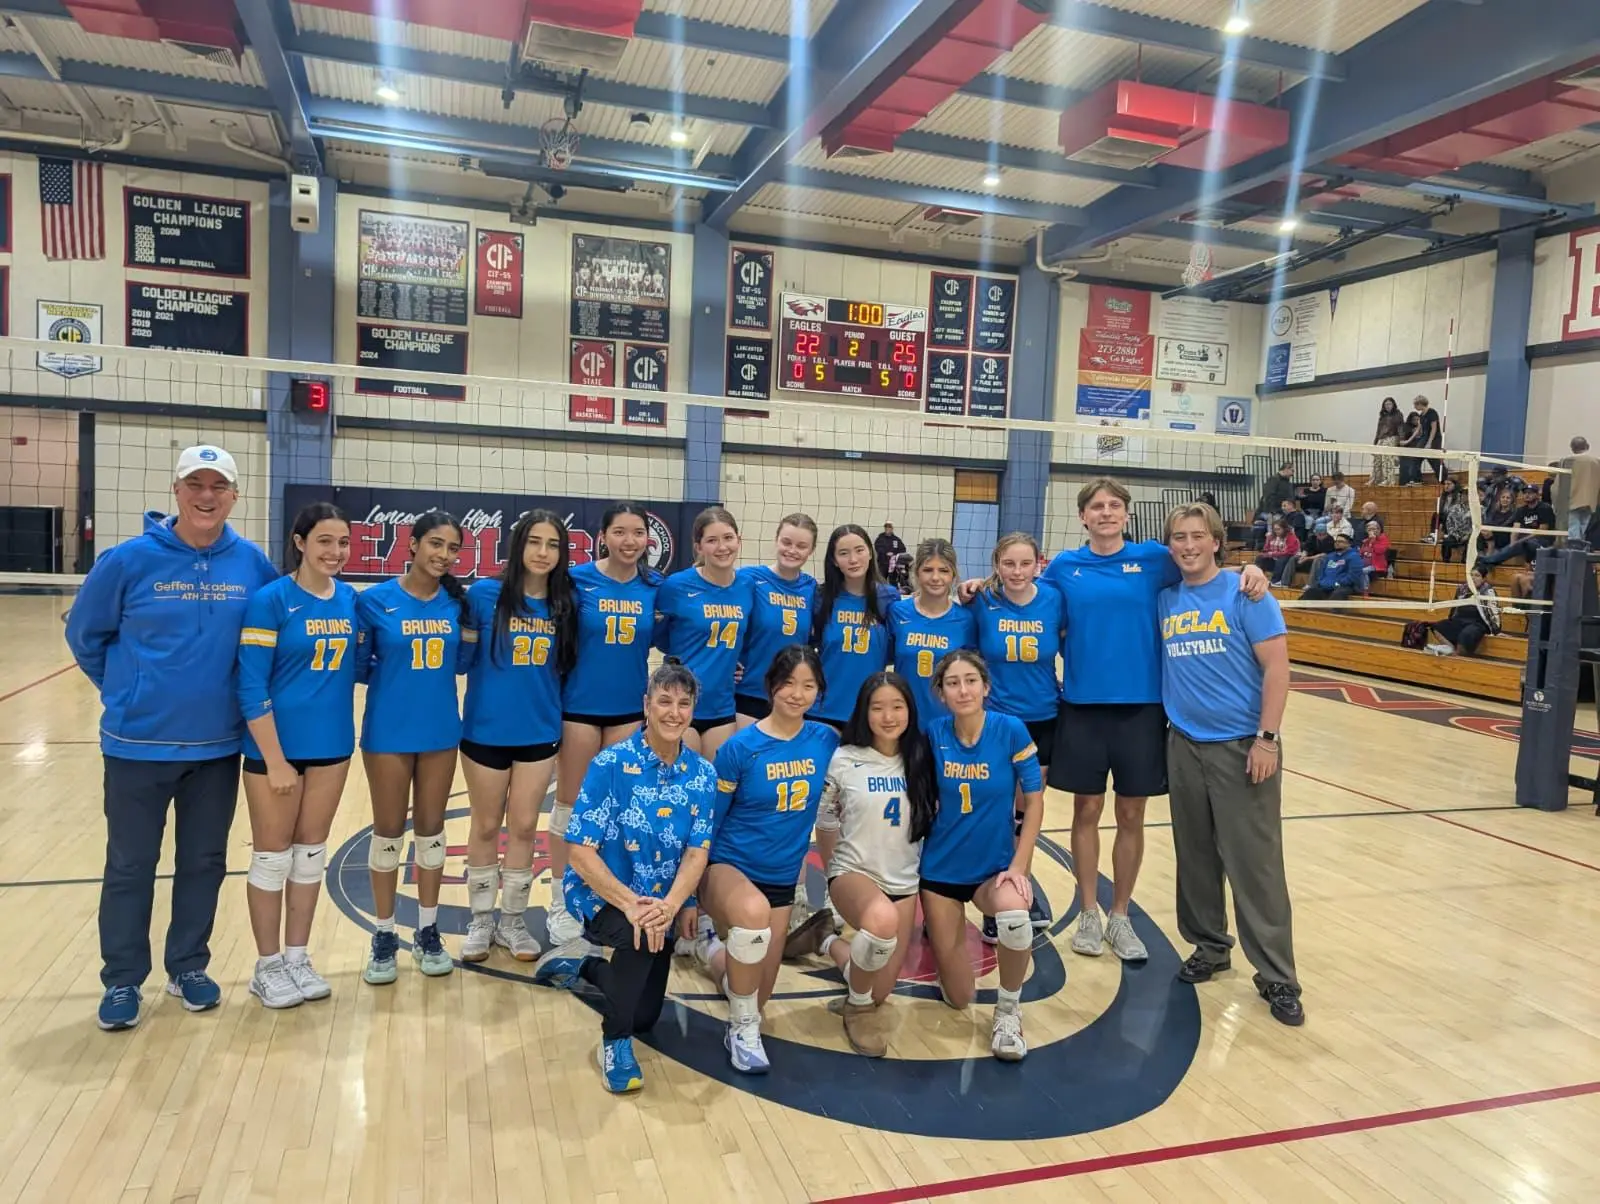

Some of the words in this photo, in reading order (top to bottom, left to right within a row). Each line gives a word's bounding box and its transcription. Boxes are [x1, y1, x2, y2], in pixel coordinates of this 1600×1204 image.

[133, 195, 182, 211] GOLDEN
[194, 202, 242, 218] LEAGUE
[134, 224, 153, 233] 2001
[153, 212, 223, 230] CHAMPIONS
[486, 243, 513, 270] CIF
[741, 261, 764, 286] CIF
[142, 286, 186, 300] GOLDEN
[190, 291, 233, 306] LEAGUE
[944, 279, 960, 296] CIF
[988, 285, 1003, 302] CIF
[155, 312, 174, 321] 2021
[156, 300, 218, 316] CHAMPIONS
[848, 303, 883, 325] 1:00
[131, 318, 151, 328] 2019
[789, 320, 822, 333] EAGLES
[887, 310, 925, 328] Eagles
[131, 328, 152, 338] 2020
[371, 328, 412, 341] GOLDEN
[416, 331, 454, 345] LEAGUE
[844, 331, 865, 339] PERIOD
[889, 331, 918, 342] GUEST
[384, 340, 441, 354] CHAMPIONS
[796, 333, 821, 355] 22
[848, 339, 860, 357] 2
[787, 354, 807, 363] FOULS
[893, 343, 917, 364] 25
[580, 352, 606, 377] CIF
[634, 356, 659, 381] CIF
[741, 363, 757, 381] CIF
[793, 363, 803, 379] 0
[815, 364, 825, 381] 5
[833, 359, 856, 368] PLAYER
[858, 360, 873, 369] FOUL
[899, 365, 918, 373] FOULS
[940, 358, 956, 375] CIF
[983, 358, 998, 374] CIF
[583, 378, 602, 386] STATE
[631, 382, 659, 390] REGIONAL
[786, 380, 806, 389] SCORE
[880, 370, 890, 387] 5
[905, 372, 915, 388] 0
[311, 385, 324, 408] 3
[393, 385, 429, 395] FOOTBALL
[841, 385, 863, 394] MATCH
[897, 389, 916, 398] SCORE
[460, 508, 503, 537] High
[652, 521, 671, 552] SCHOOL
[153, 580, 195, 592] Geffen
[200, 581, 247, 594] Academy
[599, 598, 643, 614] BRUINS
[769, 591, 807, 609] BRUINS
[703, 604, 744, 619] BRUINS
[306, 619, 353, 636] BRUINS
[401, 619, 453, 636] BRUINS
[605, 616, 637, 645] 15
[781, 609, 798, 636] 5
[998, 618, 1044, 633] BRUINS
[1161, 609, 1231, 640] UCLA
[706, 621, 740, 649] 14
[842, 626, 871, 654] 13
[906, 632, 949, 650] BRUINS
[310, 637, 348, 671] 17
[411, 637, 445, 670] 18
[512, 635, 551, 665] 26
[1005, 635, 1039, 662] 16
[1165, 638, 1227, 657] VOLLEYBALL
[766, 758, 816, 781] BRUINS
[943, 760, 990, 780] BRUINS
[867, 775, 908, 793] BRUIN
[775, 780, 810, 812] 12
[959, 783, 973, 814] 1
[882, 797, 901, 827] 4
